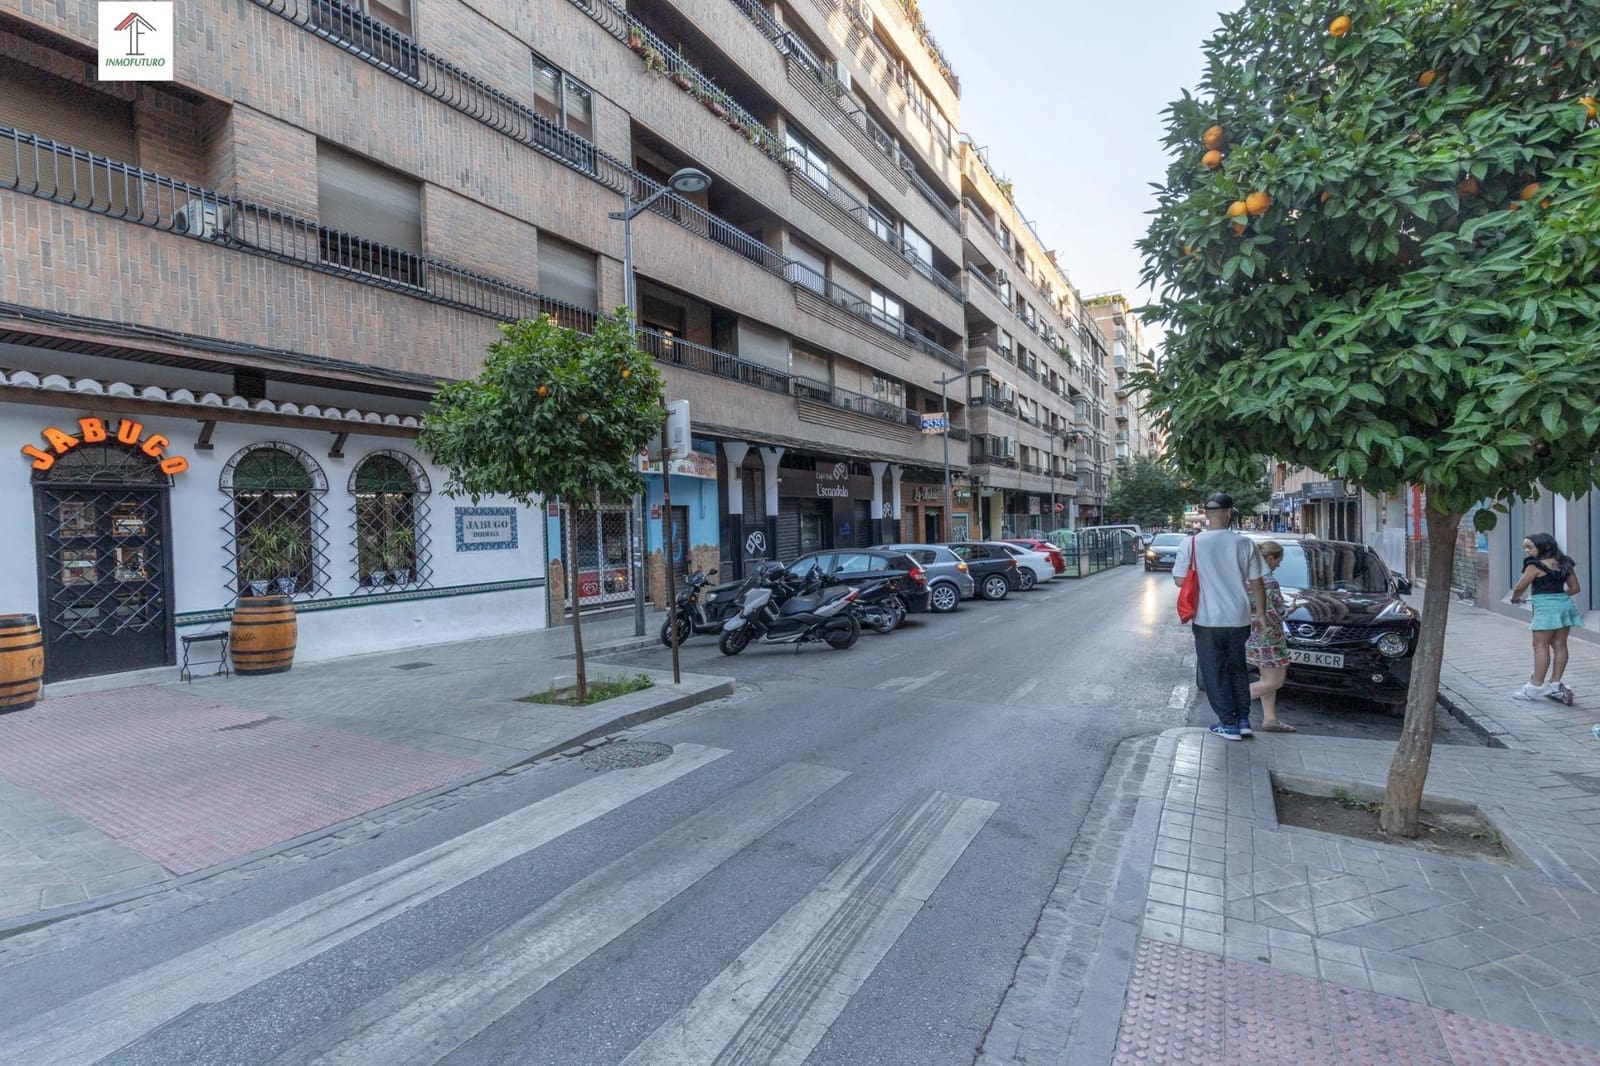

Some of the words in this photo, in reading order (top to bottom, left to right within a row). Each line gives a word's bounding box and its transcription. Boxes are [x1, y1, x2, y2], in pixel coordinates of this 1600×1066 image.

[21, 416, 190, 475] JABUGO
[465, 521, 509, 529] JABUGO
[1315, 653, 1341, 667] KCR
